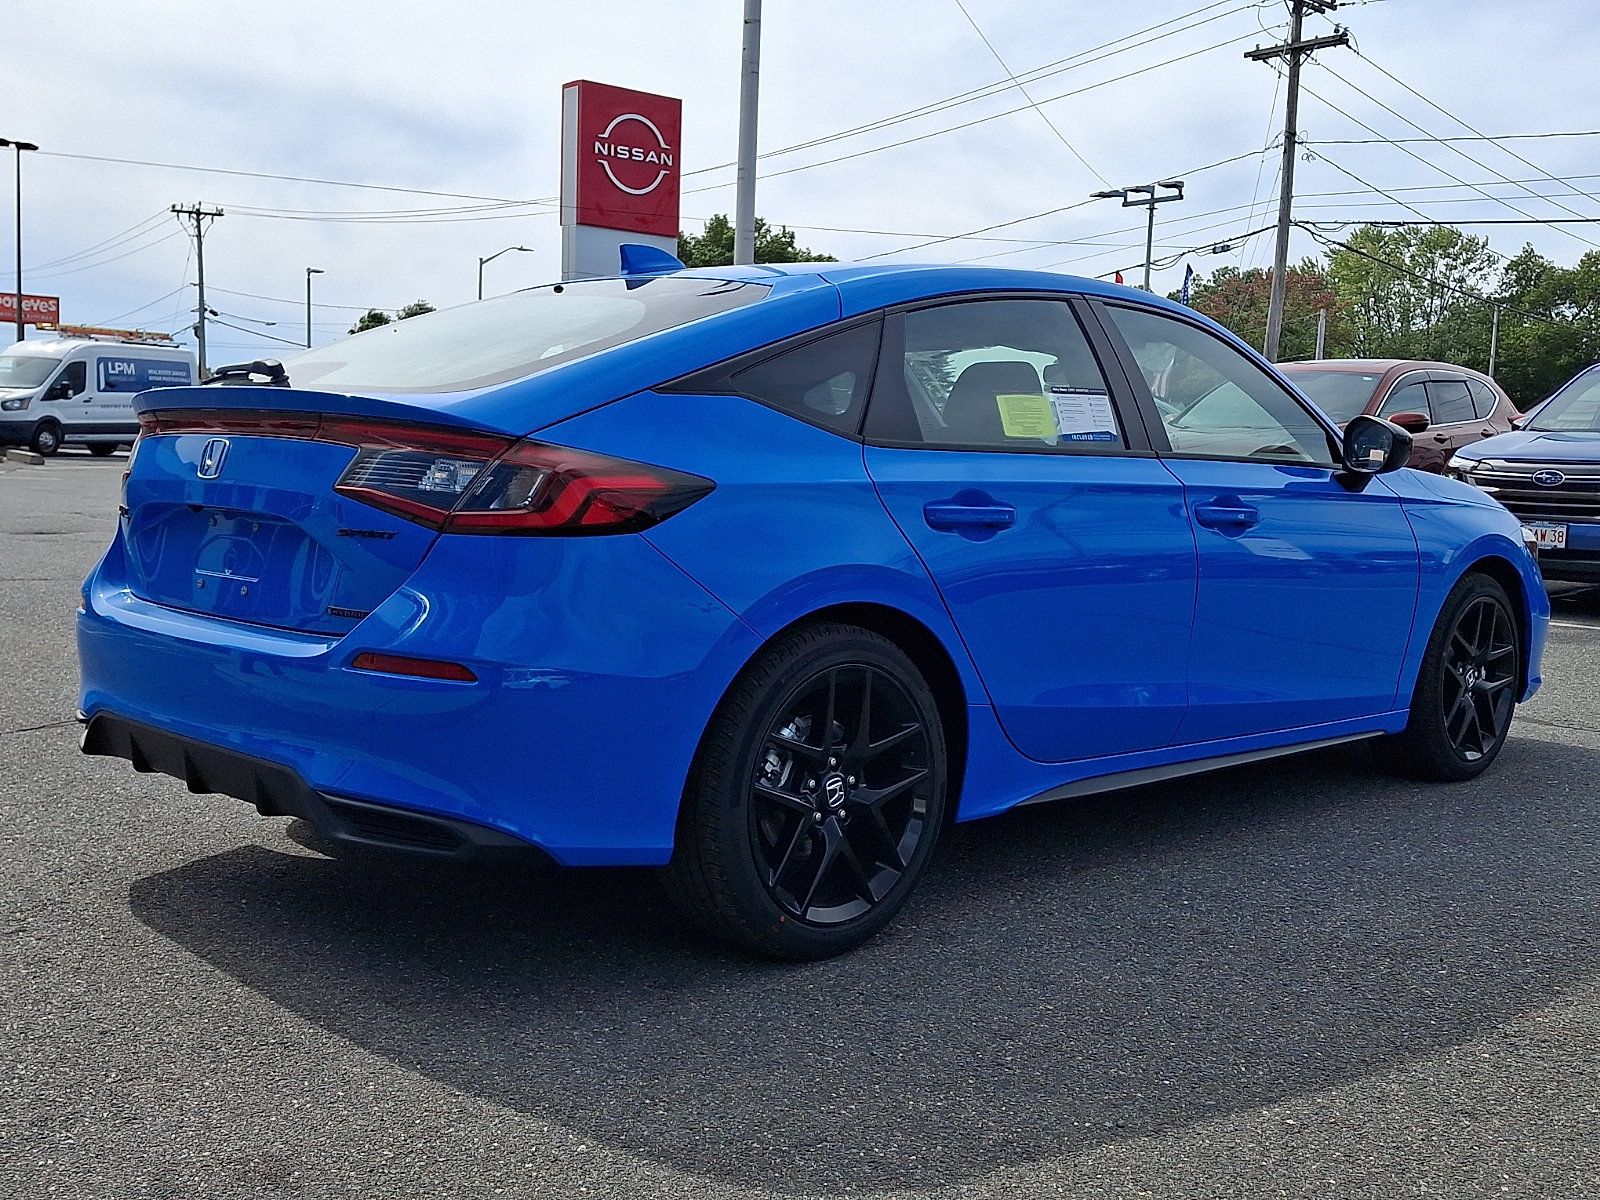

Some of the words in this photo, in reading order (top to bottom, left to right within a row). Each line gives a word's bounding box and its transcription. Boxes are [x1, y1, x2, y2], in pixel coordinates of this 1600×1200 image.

[594, 141, 673, 167] NISSAN
[107, 361, 136, 375] LPM
[1549, 529, 1565, 543] 38
